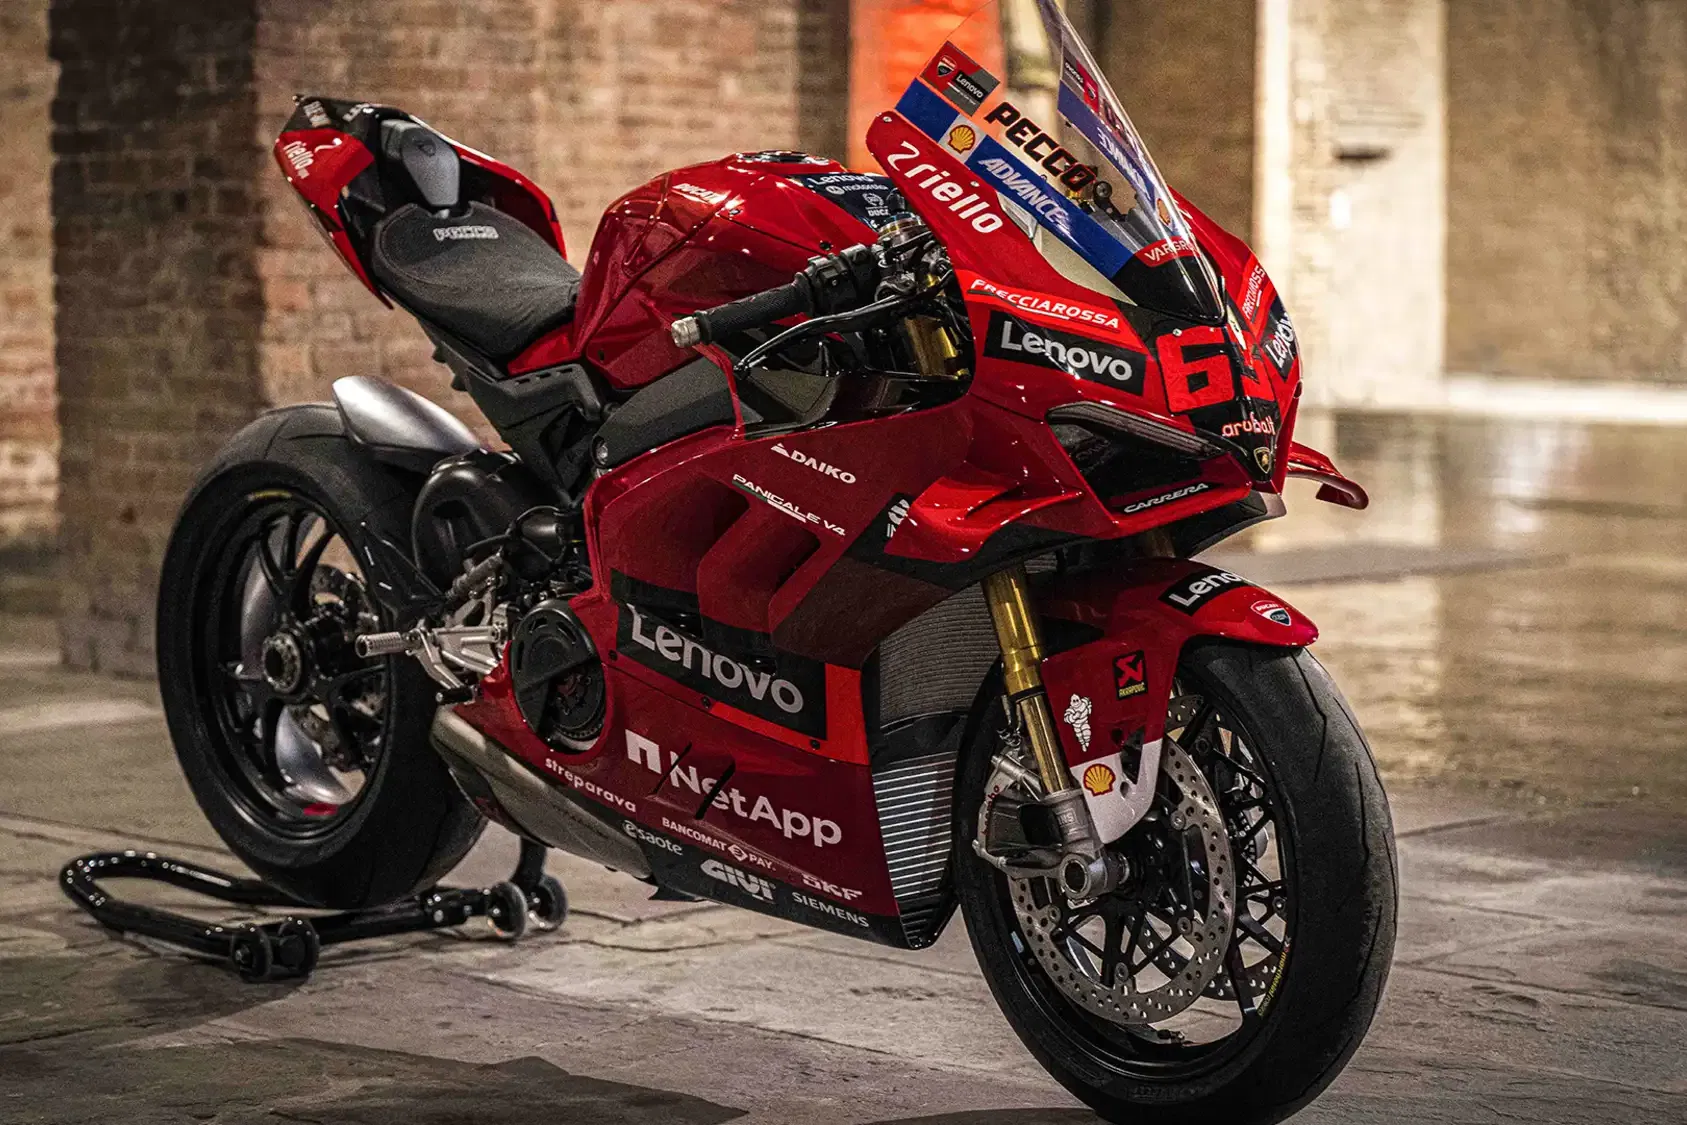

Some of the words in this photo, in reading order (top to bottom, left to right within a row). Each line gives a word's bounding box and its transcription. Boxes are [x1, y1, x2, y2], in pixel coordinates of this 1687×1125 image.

[956, 73, 984, 98] Lenovo
[984, 101, 1098, 193] PECCO
[806, 174, 875, 185] Lenovo
[904, 162, 1004, 234] riello
[977, 157, 1069, 224] ADVANCE
[970, 278, 1119, 329] FRECCIAROSSA
[1001, 320, 1133, 381] Lenovo
[732, 473, 822, 524] PANIGALE
[823, 518, 847, 537] V4
[1123, 482, 1209, 514] CARRERA
[1168, 571, 1242, 607] Leno
[626, 602, 805, 714] Lenovo
[545, 757, 637, 813] streparava
[669, 750, 843, 848] NetApp
[622, 818, 684, 856] esaote
[661, 816, 728, 852] BANCOMAT
[791, 891, 870, 928] SIEMENS
[801, 872, 863, 901] SKF
